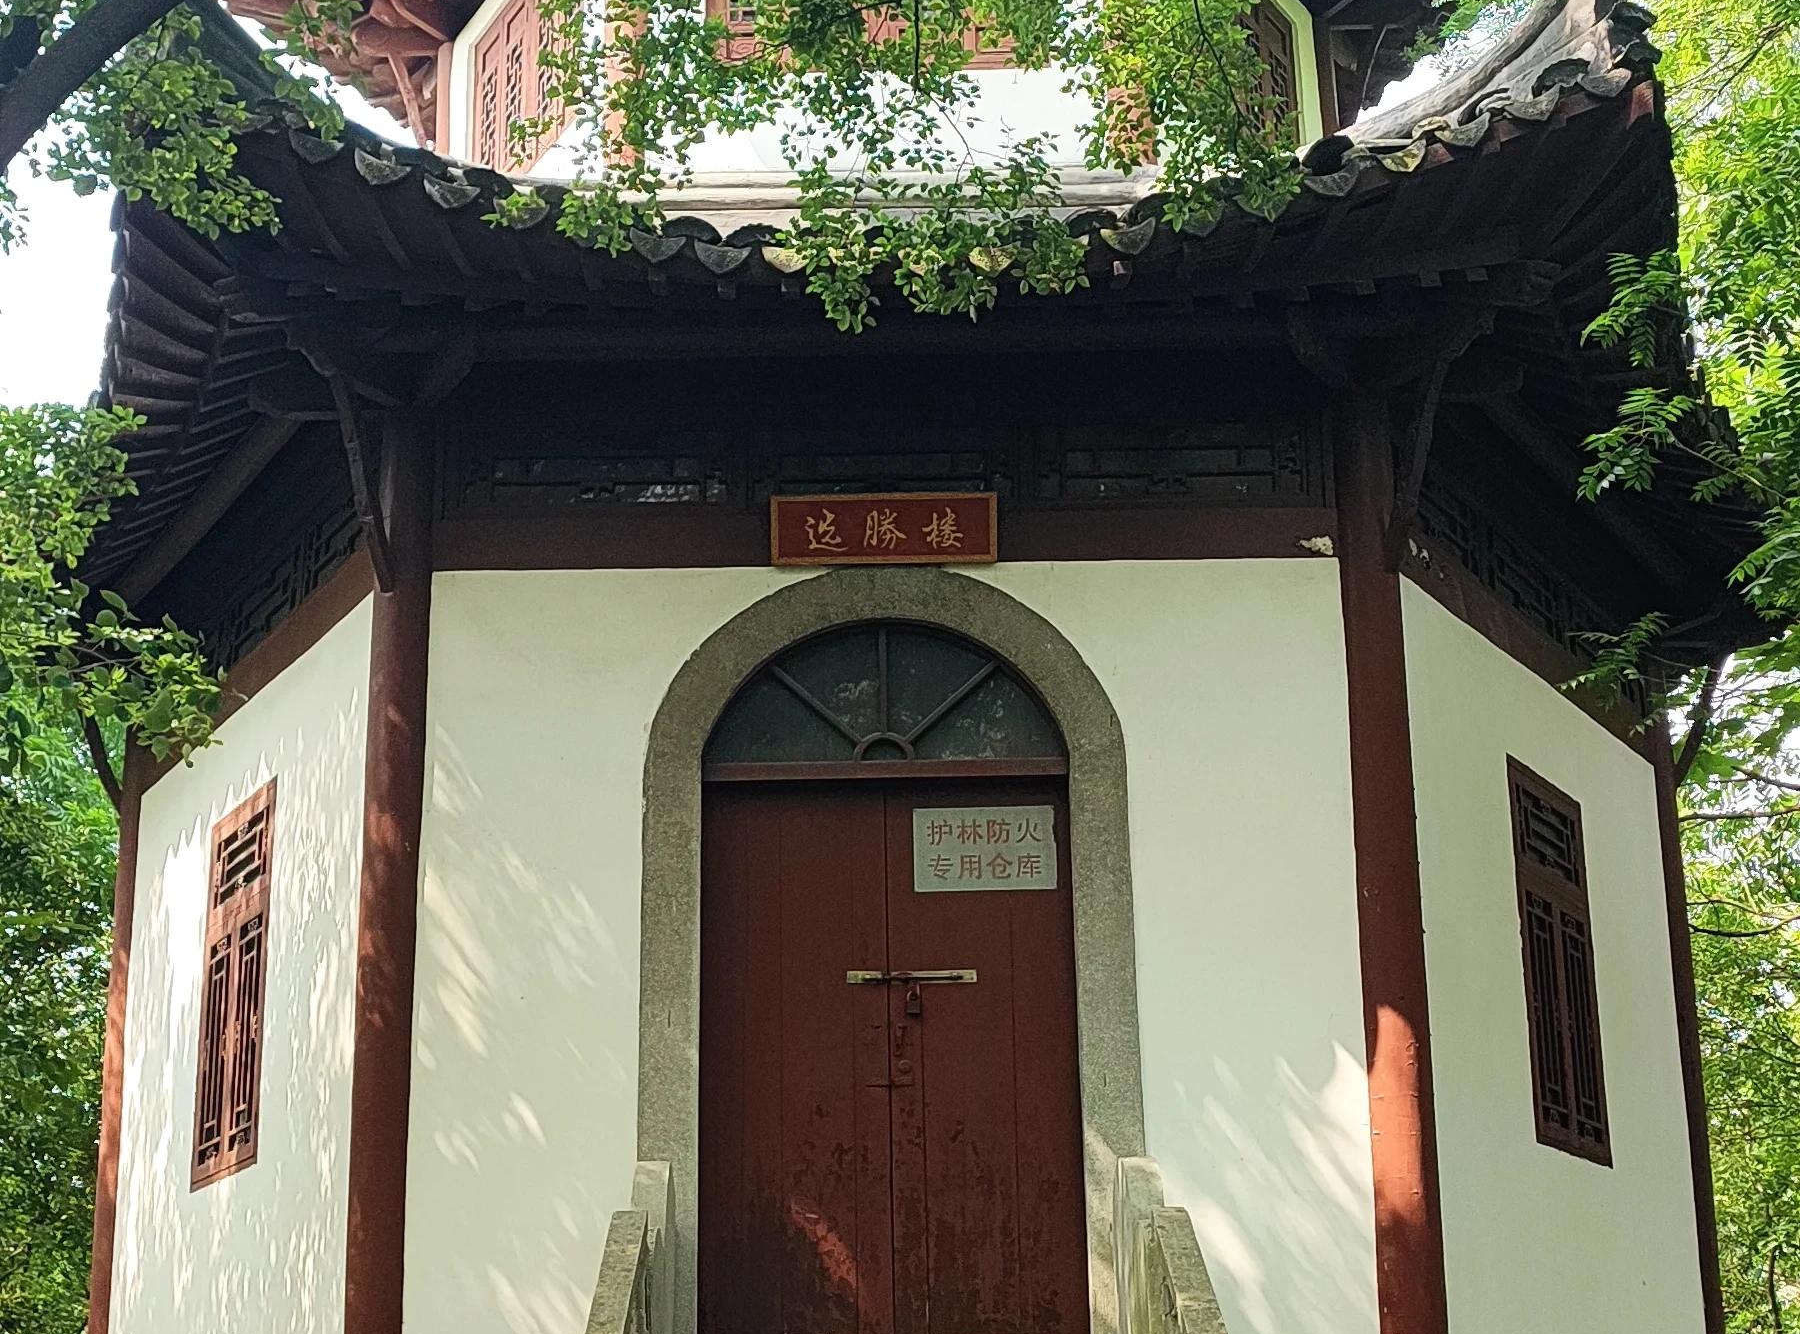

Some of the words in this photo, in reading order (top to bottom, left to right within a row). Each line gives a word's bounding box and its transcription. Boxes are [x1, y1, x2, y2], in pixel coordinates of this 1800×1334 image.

[926, 818, 1043, 846] 护林防火
[927, 853, 1043, 880] 专用仓库
